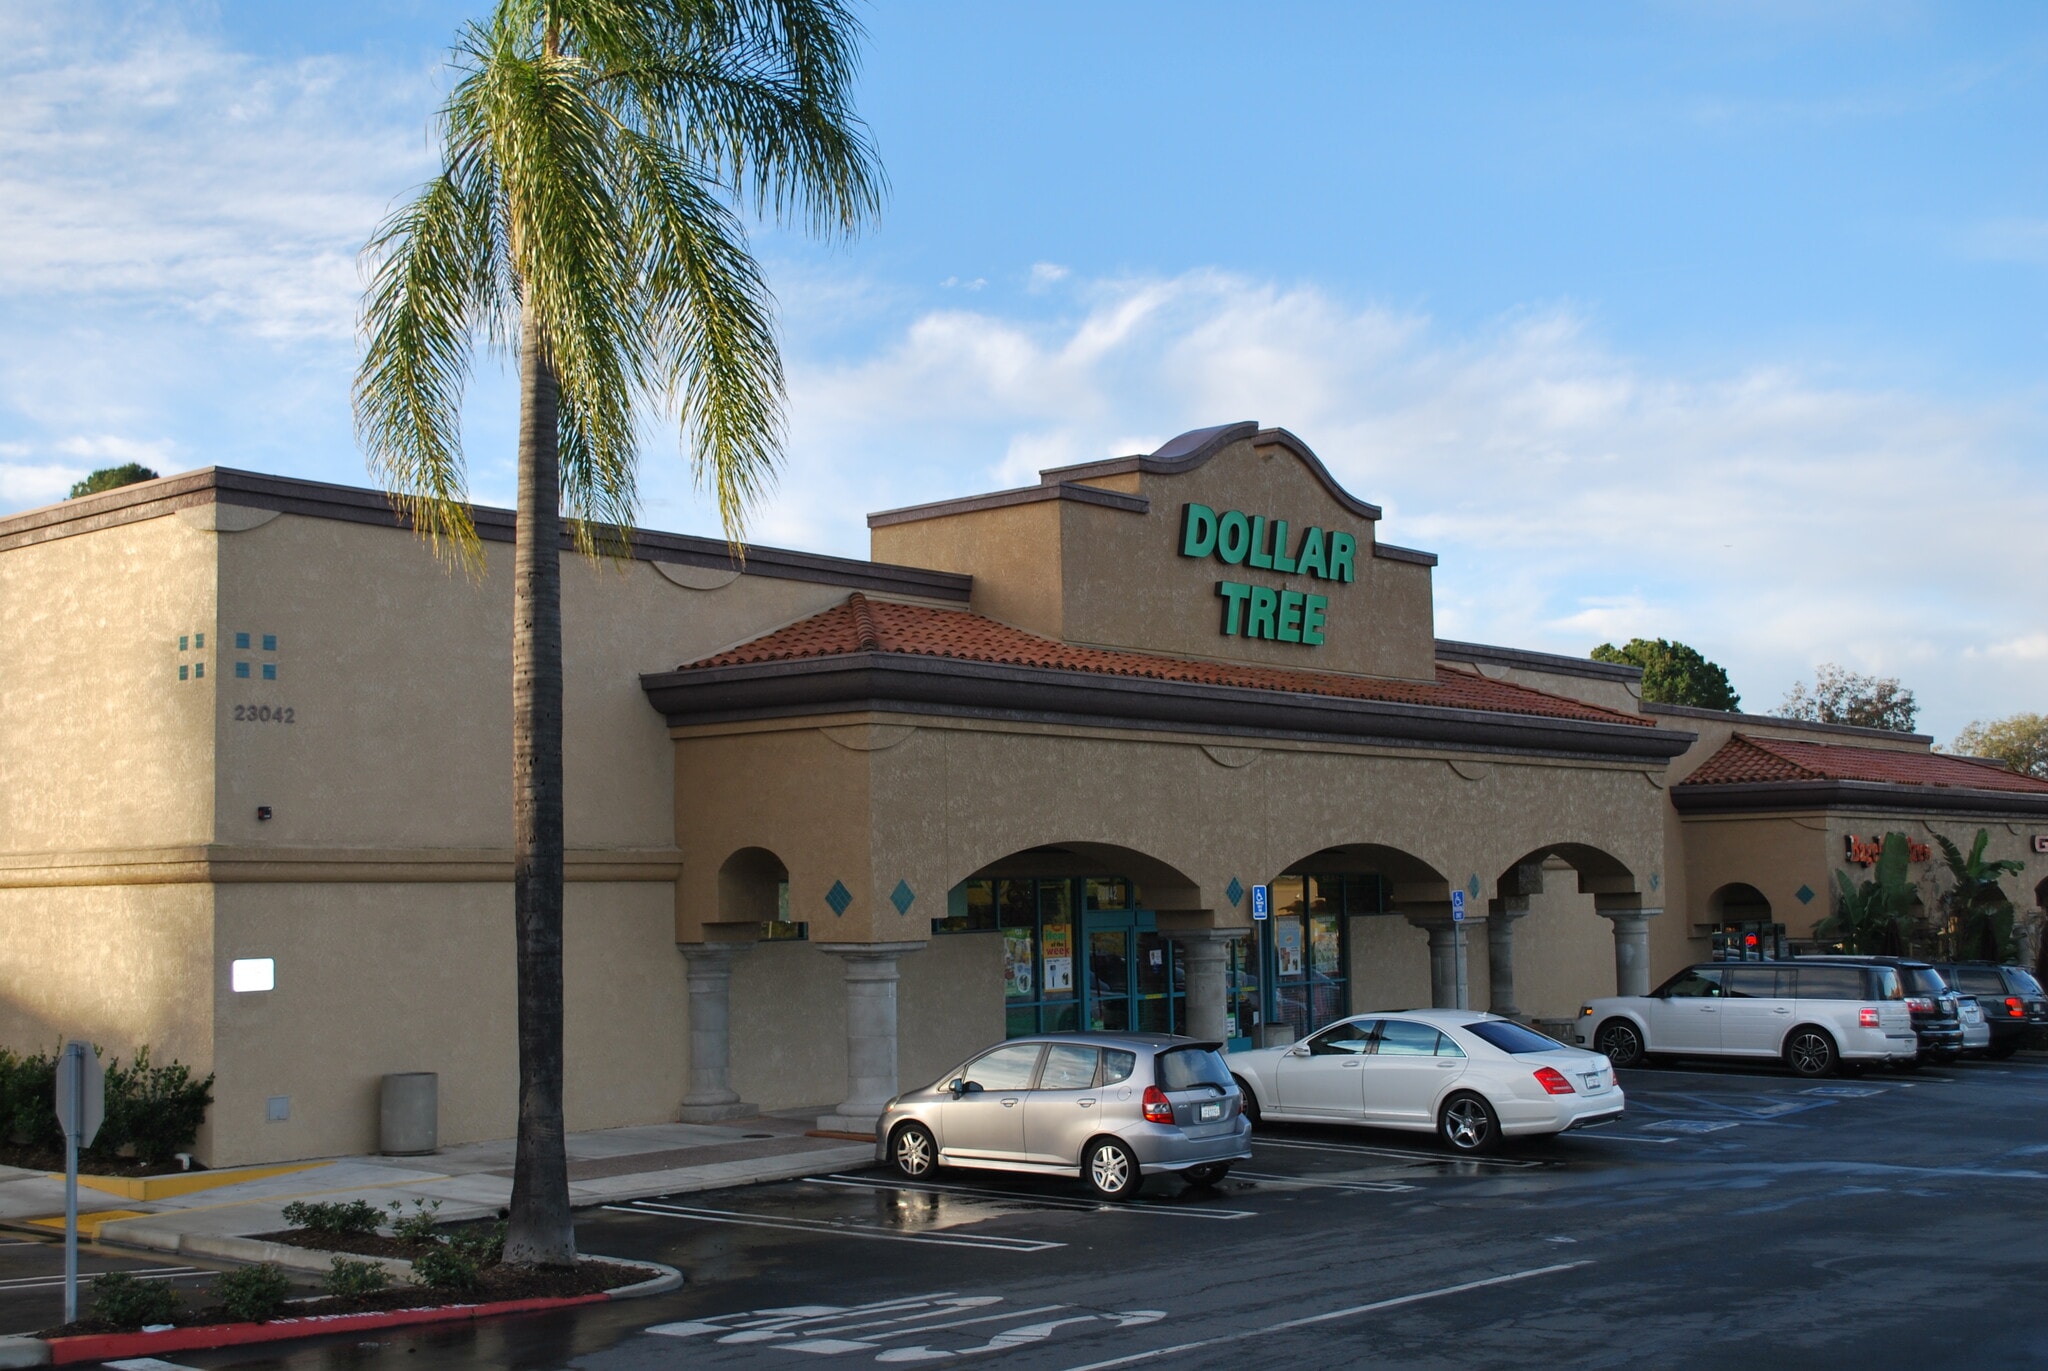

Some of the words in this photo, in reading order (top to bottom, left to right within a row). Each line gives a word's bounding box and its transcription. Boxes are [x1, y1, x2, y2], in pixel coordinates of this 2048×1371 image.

[1179, 502, 1356, 583] DOLLAR
[1216, 581, 1328, 645] TREE
[233, 703, 295, 723] 23042
[1046, 947, 1071, 956] week
[644, 1293, 1168, 1361] STOP
